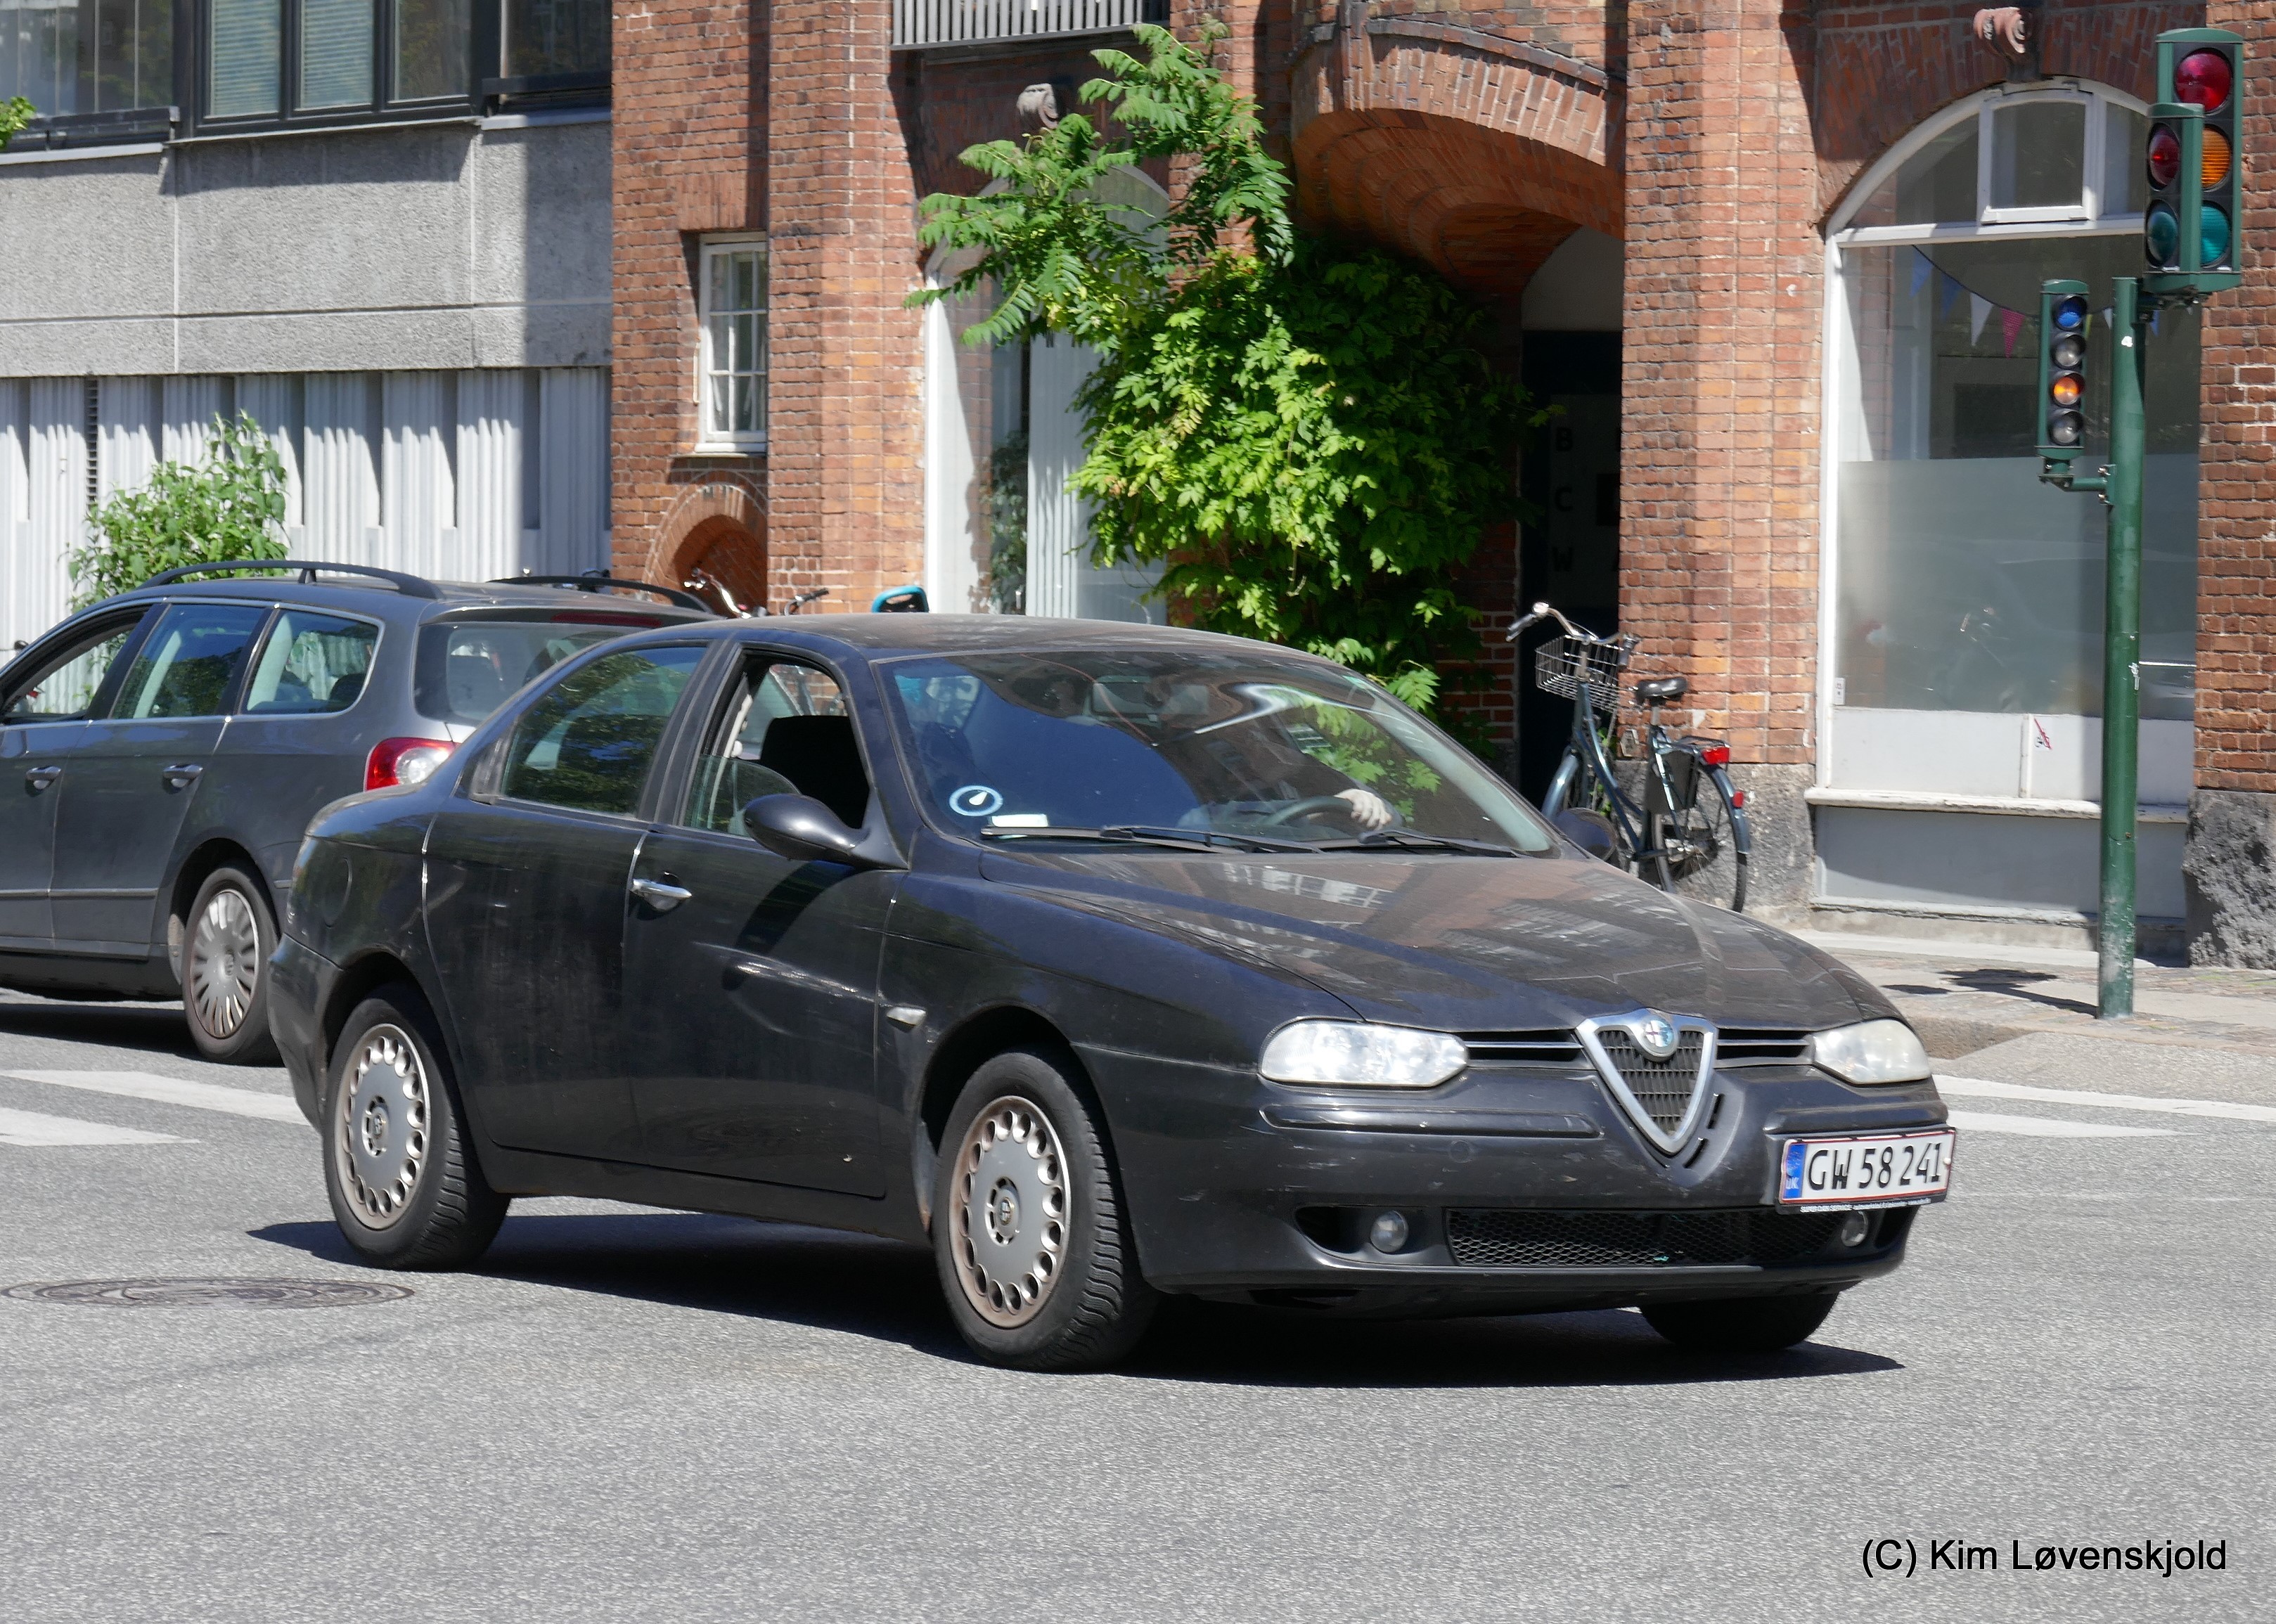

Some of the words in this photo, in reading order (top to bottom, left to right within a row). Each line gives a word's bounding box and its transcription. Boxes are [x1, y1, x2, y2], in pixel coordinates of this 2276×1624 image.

[1555, 426, 1574, 451] B
[1554, 486, 1573, 513] C
[1808, 1149, 1853, 1190] GW
[1858, 1146, 1894, 1189] 58
[1900, 1142, 1942, 1186] 241
